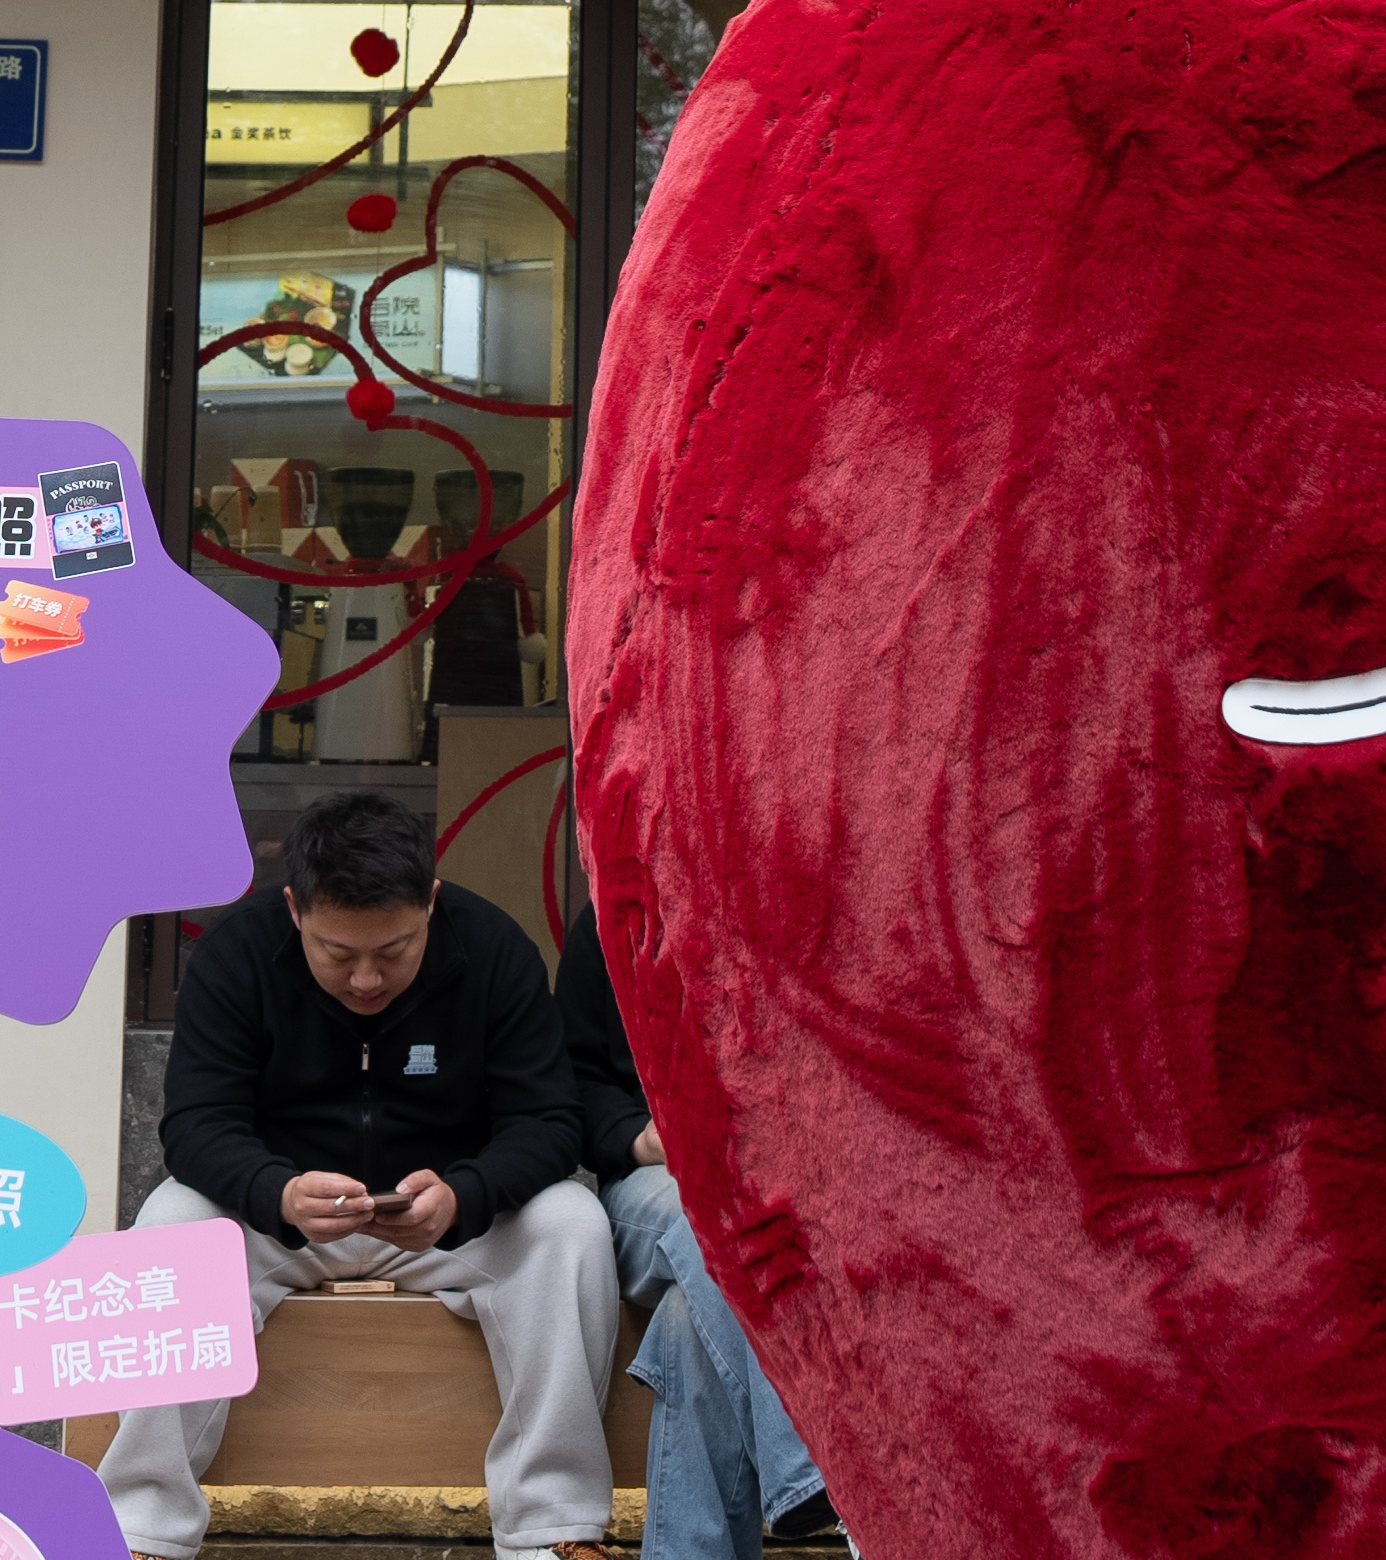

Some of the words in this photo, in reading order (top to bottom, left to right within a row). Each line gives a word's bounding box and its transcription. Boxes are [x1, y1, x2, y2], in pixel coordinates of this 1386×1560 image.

[50, 479, 114, 500] PASSPORT
[12, 592, 63, 618] 打车券
